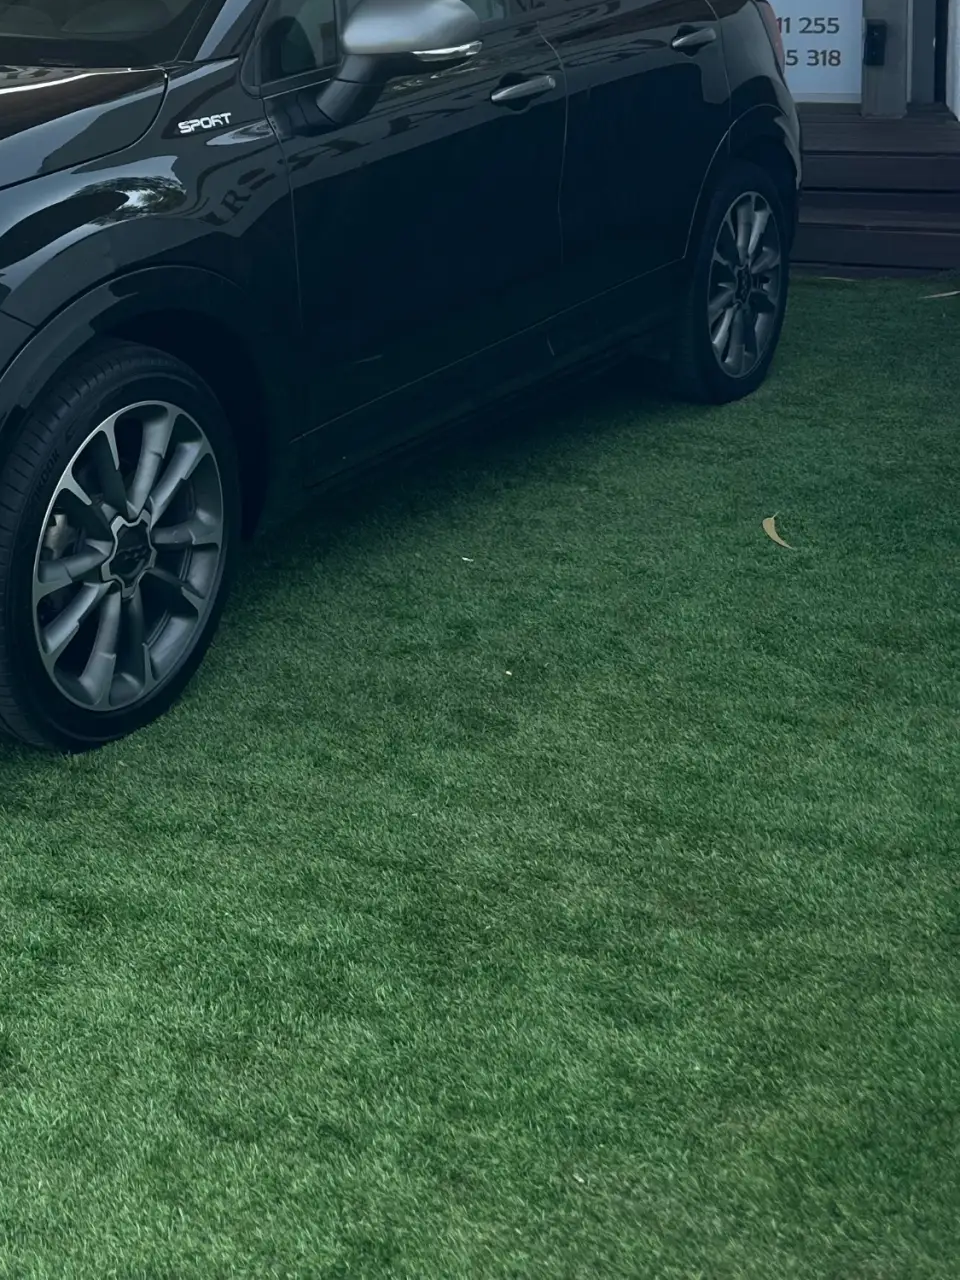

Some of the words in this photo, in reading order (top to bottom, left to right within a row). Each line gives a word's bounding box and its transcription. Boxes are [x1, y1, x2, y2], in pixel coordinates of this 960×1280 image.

[798, 17, 840, 34] 255
[806, 49, 841, 67] 318
[177, 112, 232, 134] SPORT
